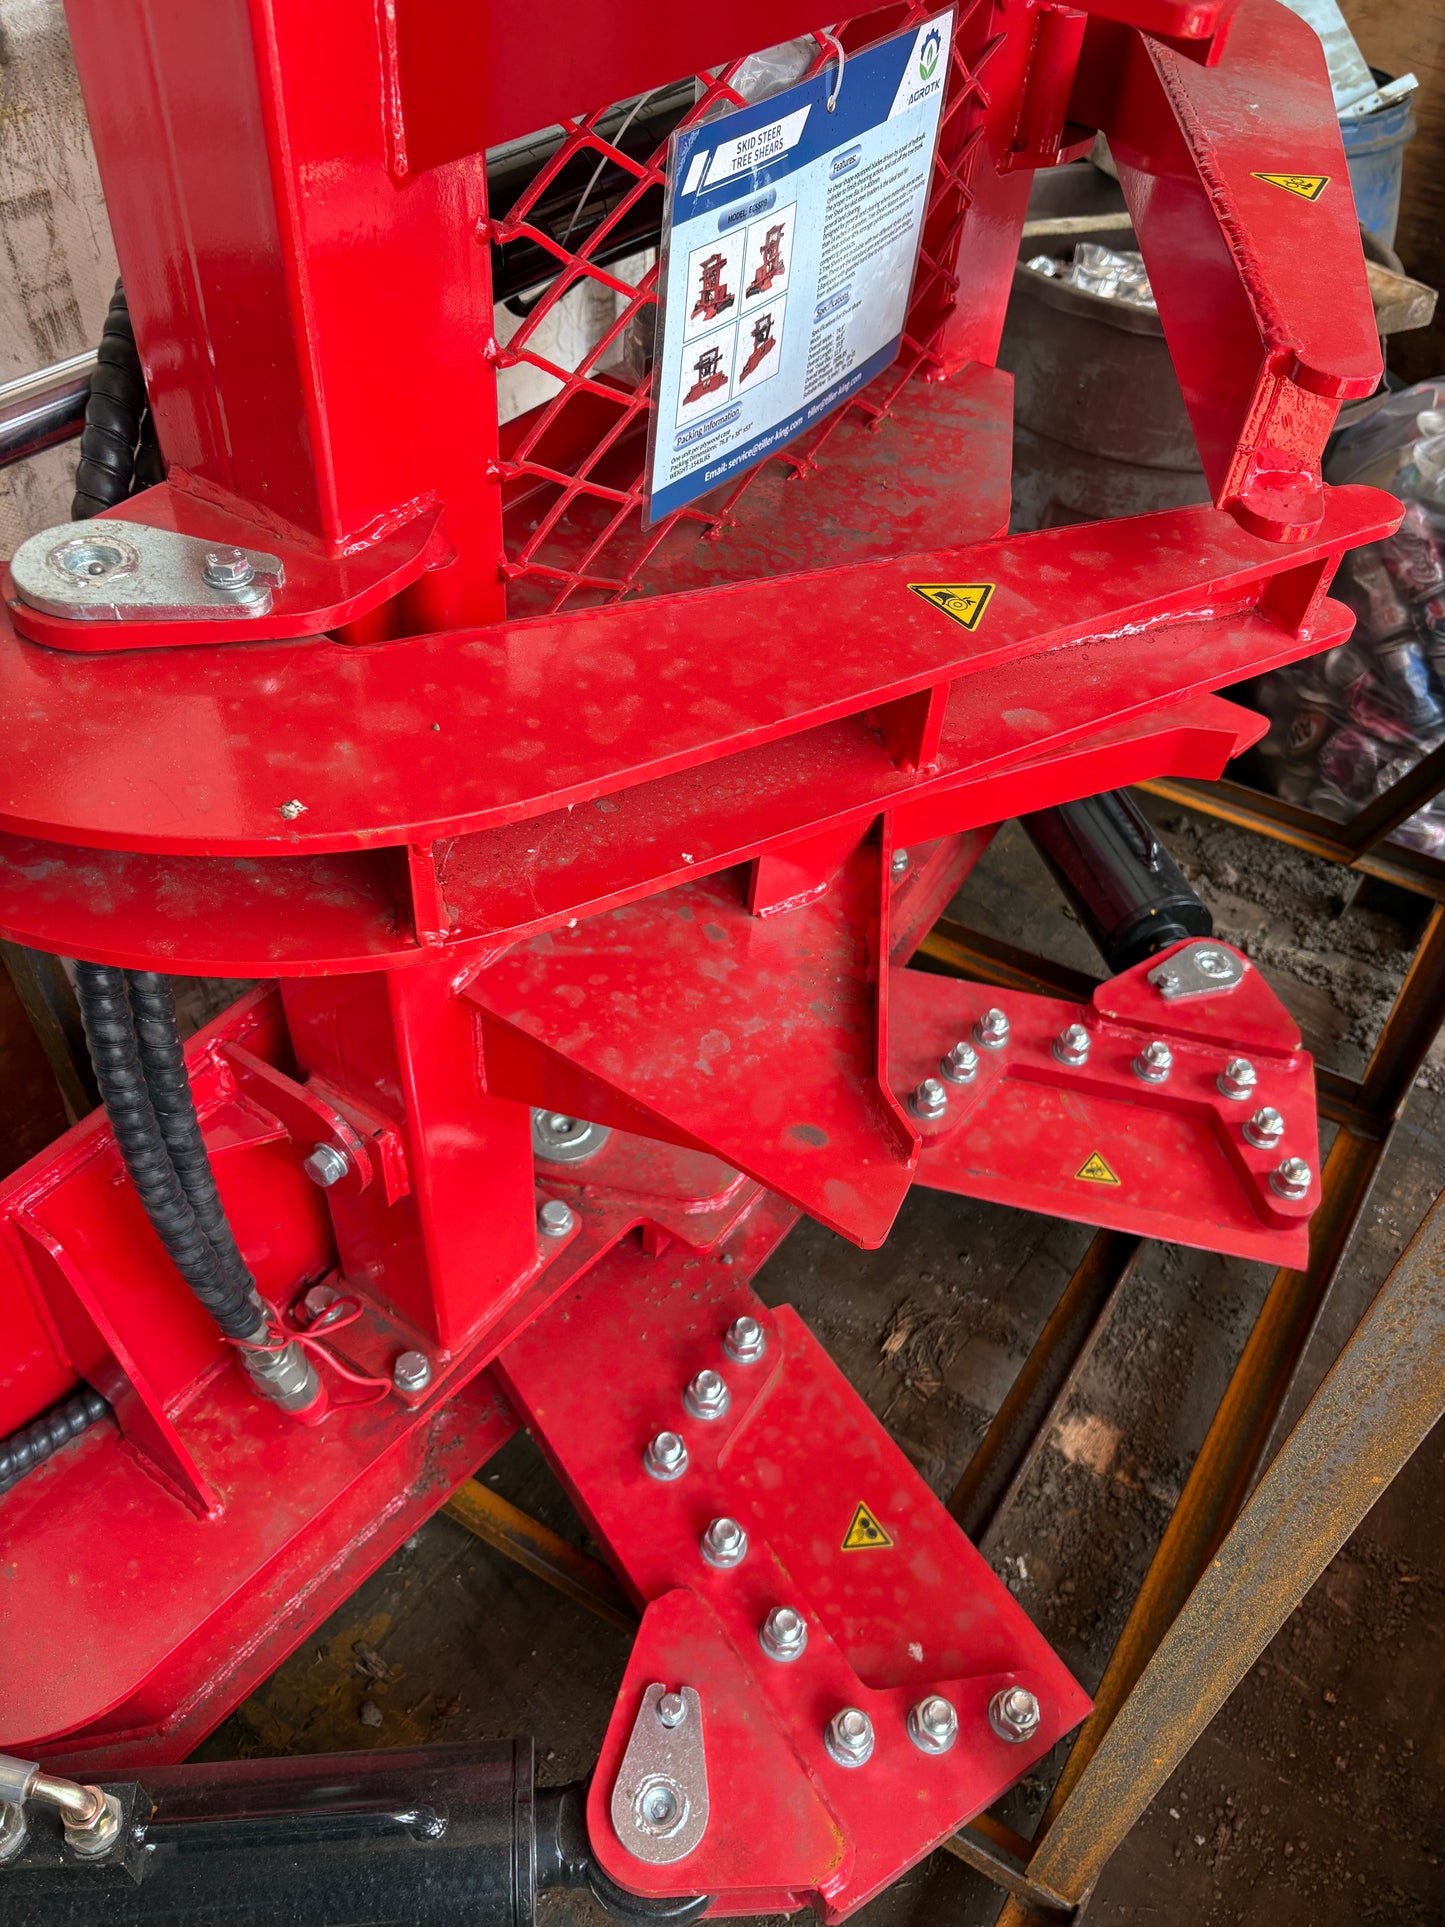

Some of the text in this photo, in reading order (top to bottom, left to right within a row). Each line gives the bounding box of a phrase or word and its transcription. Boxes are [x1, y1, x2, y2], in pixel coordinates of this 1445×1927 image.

[908, 77, 940, 105] AGROTK
[730, 137, 784, 171] TREE SHEARS
[736, 123, 782, 155] SKID STEER
[727, 207, 747, 223] MODEL:
[676, 407, 739, 446] Packing Information
[704, 371, 862, 482] Email: service@tiller-king.com tiller@tiller-king.com
[670, 428, 730, 465] One unit per plywood case
[669, 464, 689, 480] WEIGHT
[670, 457, 689, 472] Packing
